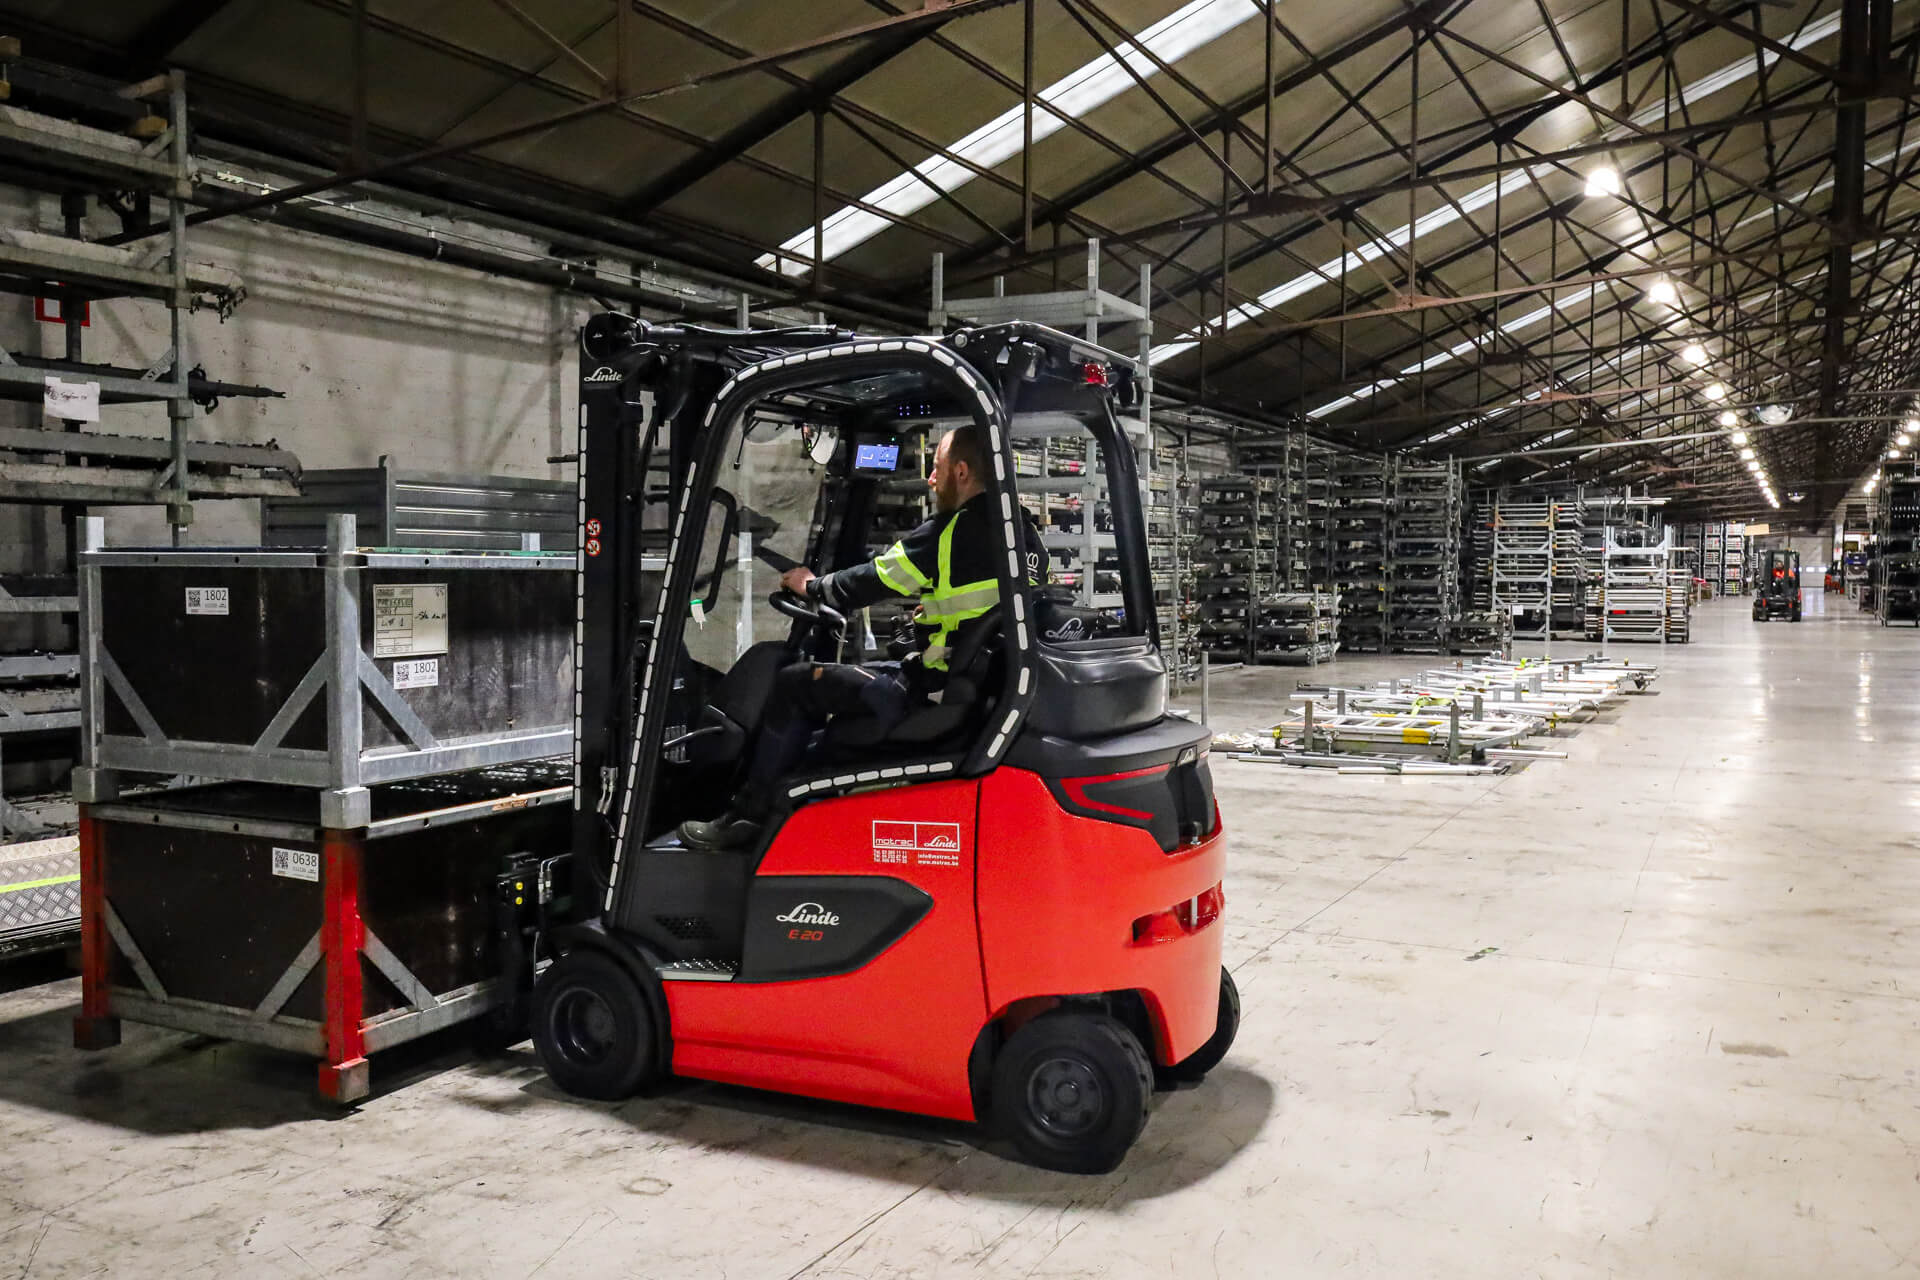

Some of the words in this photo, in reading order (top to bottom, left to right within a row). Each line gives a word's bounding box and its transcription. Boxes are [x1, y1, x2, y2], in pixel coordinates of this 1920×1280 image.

[583, 366, 622, 382] Linde
[205, 590, 227, 600] 1802
[414, 661, 436, 673] 1802
[875, 838, 914, 847] motrac
[924, 835, 957, 848] Linde
[293, 852, 317, 867] 0638
[776, 902, 840, 926] Linde
